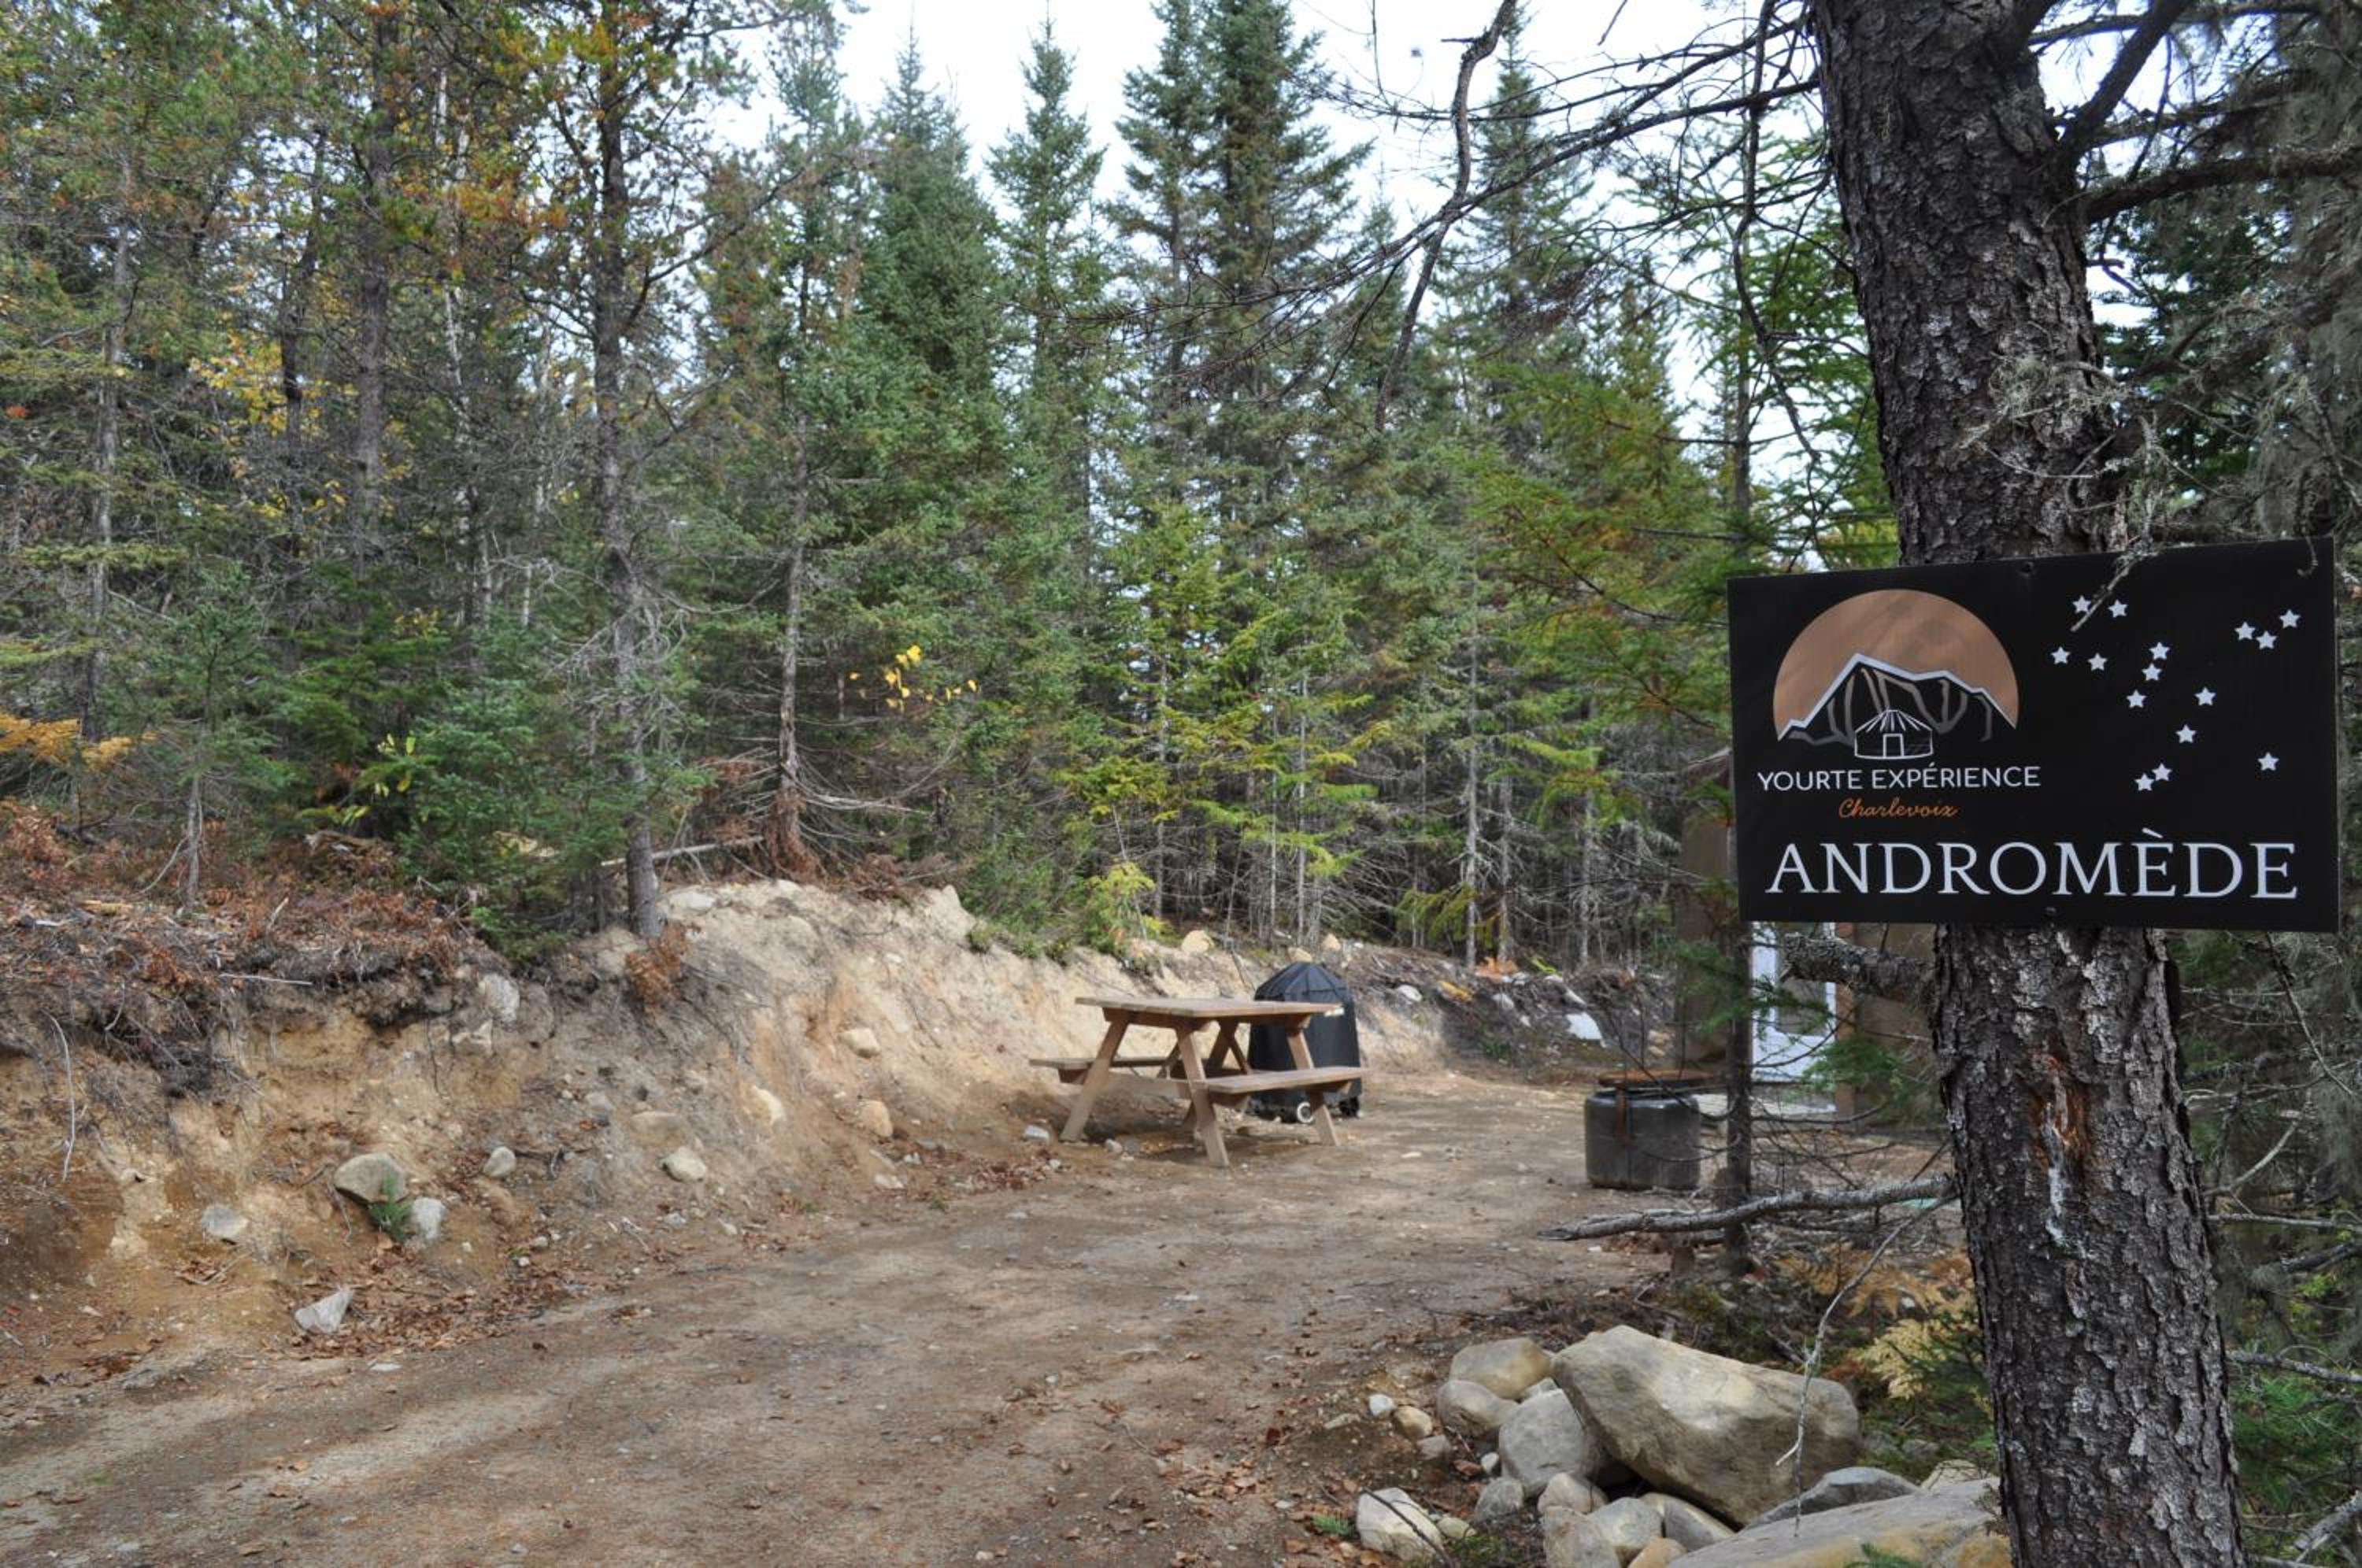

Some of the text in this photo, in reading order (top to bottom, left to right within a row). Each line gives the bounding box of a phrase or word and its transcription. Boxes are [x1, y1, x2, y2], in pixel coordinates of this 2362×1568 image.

[1757, 762, 2042, 792] YOURTE EXPÉRIENCE
[1838, 797, 1958, 818] Charlevoix
[1764, 827, 2298, 899] ANDROMÈDE
